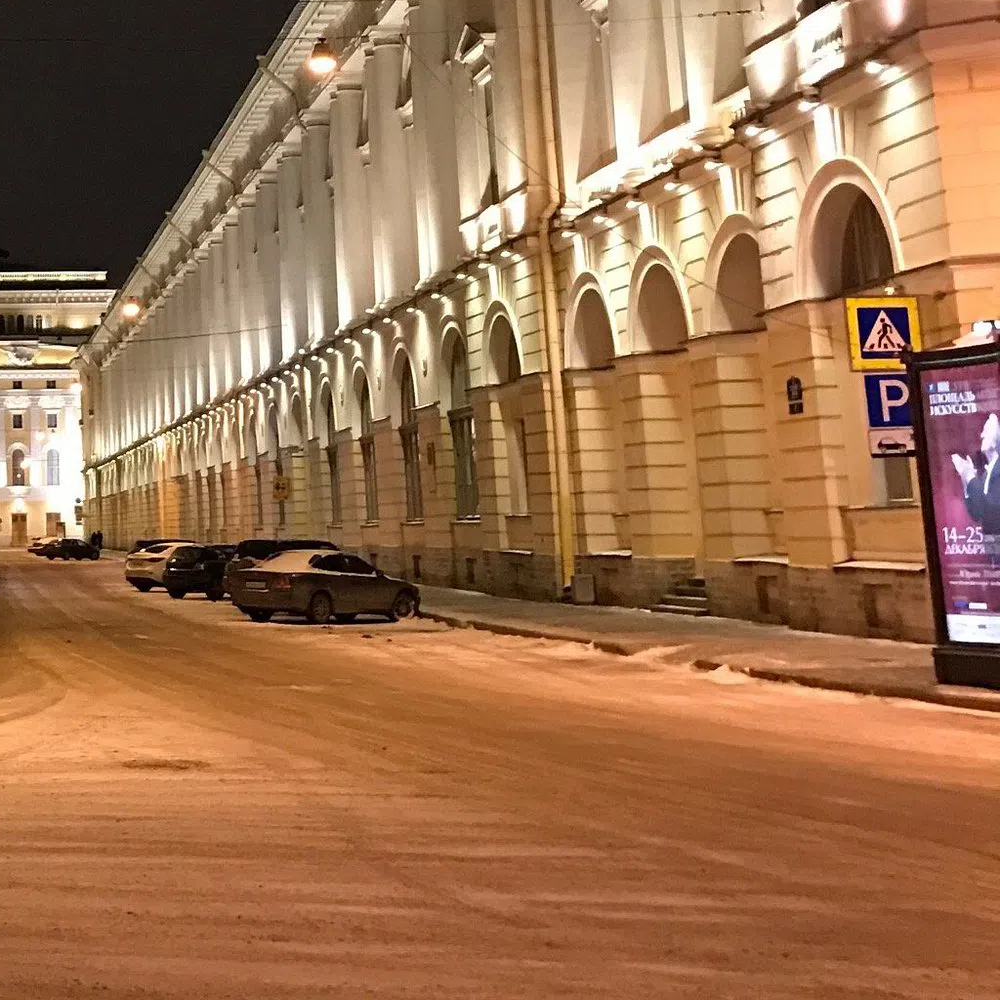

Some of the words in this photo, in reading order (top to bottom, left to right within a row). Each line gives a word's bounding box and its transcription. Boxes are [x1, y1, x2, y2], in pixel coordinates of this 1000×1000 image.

[879, 379, 909, 422] P
[930, 403, 977, 416] ИСКУССТВ
[944, 543, 986, 554] ДЕКАБРЯ
